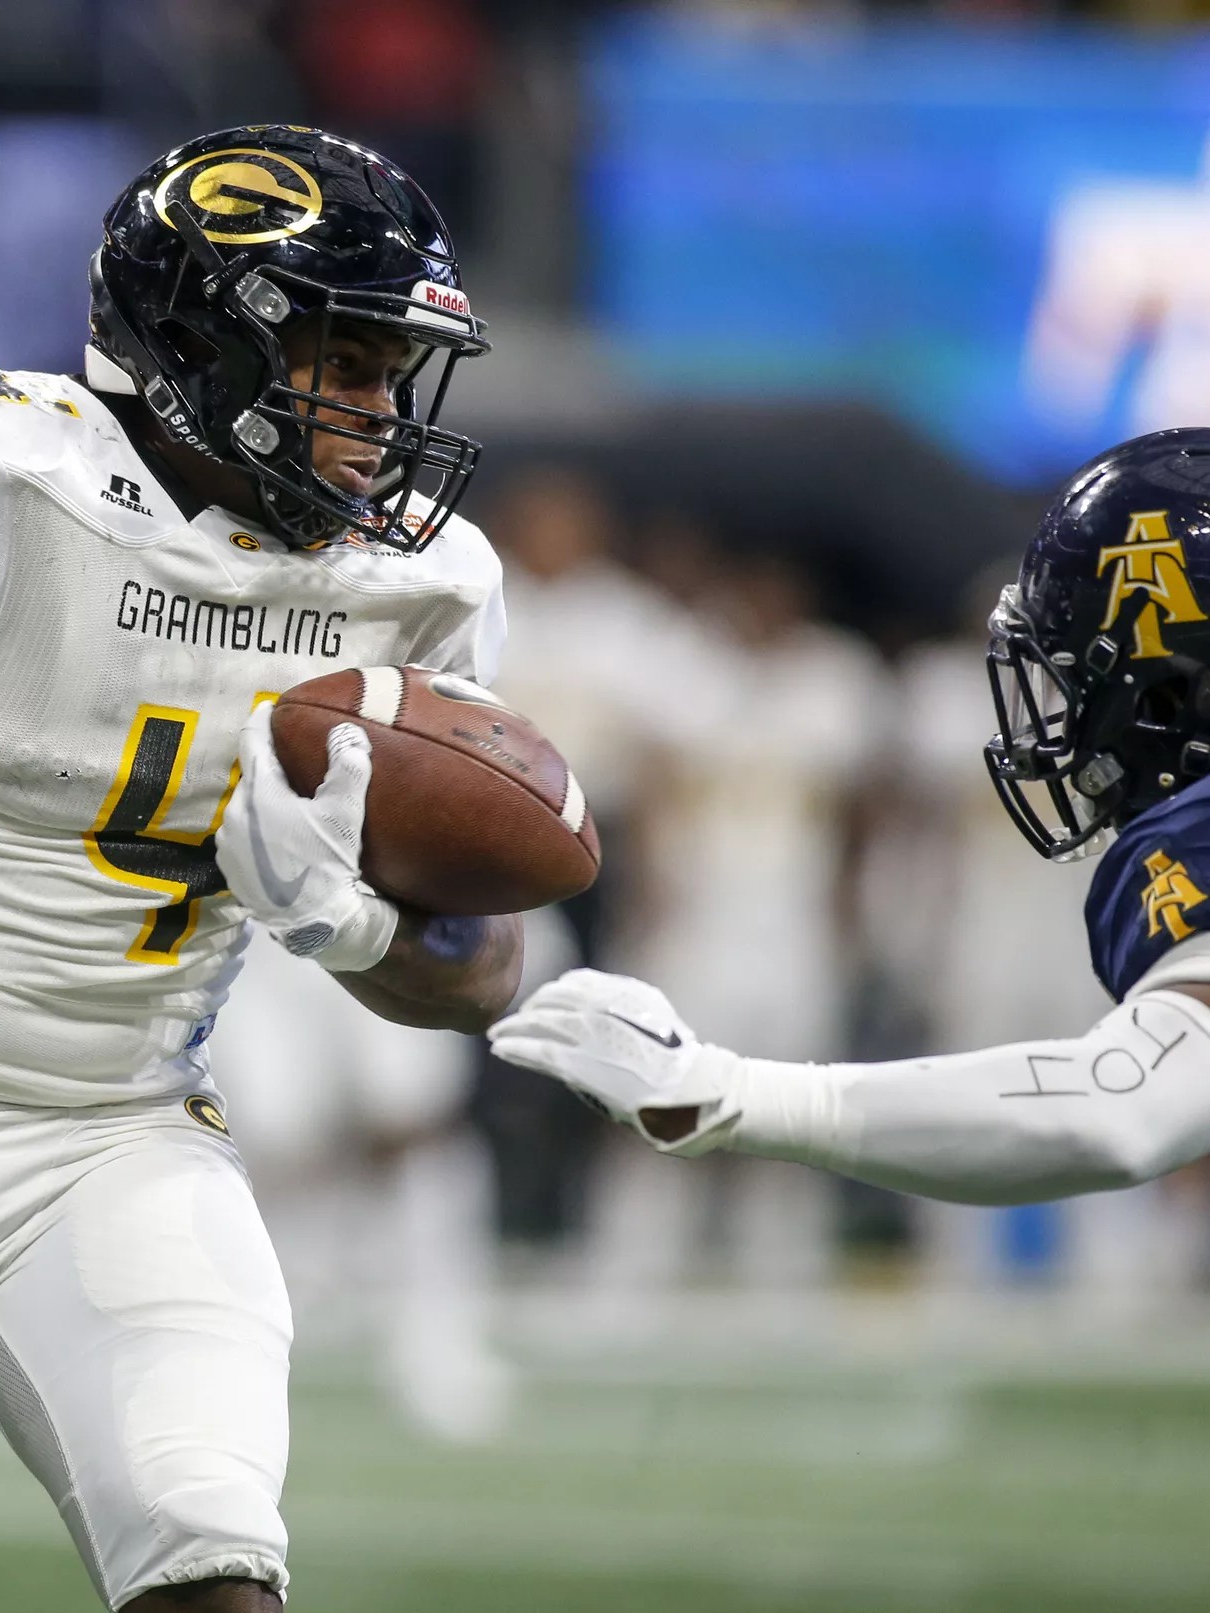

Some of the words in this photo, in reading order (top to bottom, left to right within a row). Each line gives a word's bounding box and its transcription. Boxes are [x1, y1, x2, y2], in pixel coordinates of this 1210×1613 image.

[425, 285, 470, 316] Riddell
[100, 490, 154, 518] RUSSELL
[117, 580, 347, 657] GRAMBLING
[82, 690, 278, 966] 4
